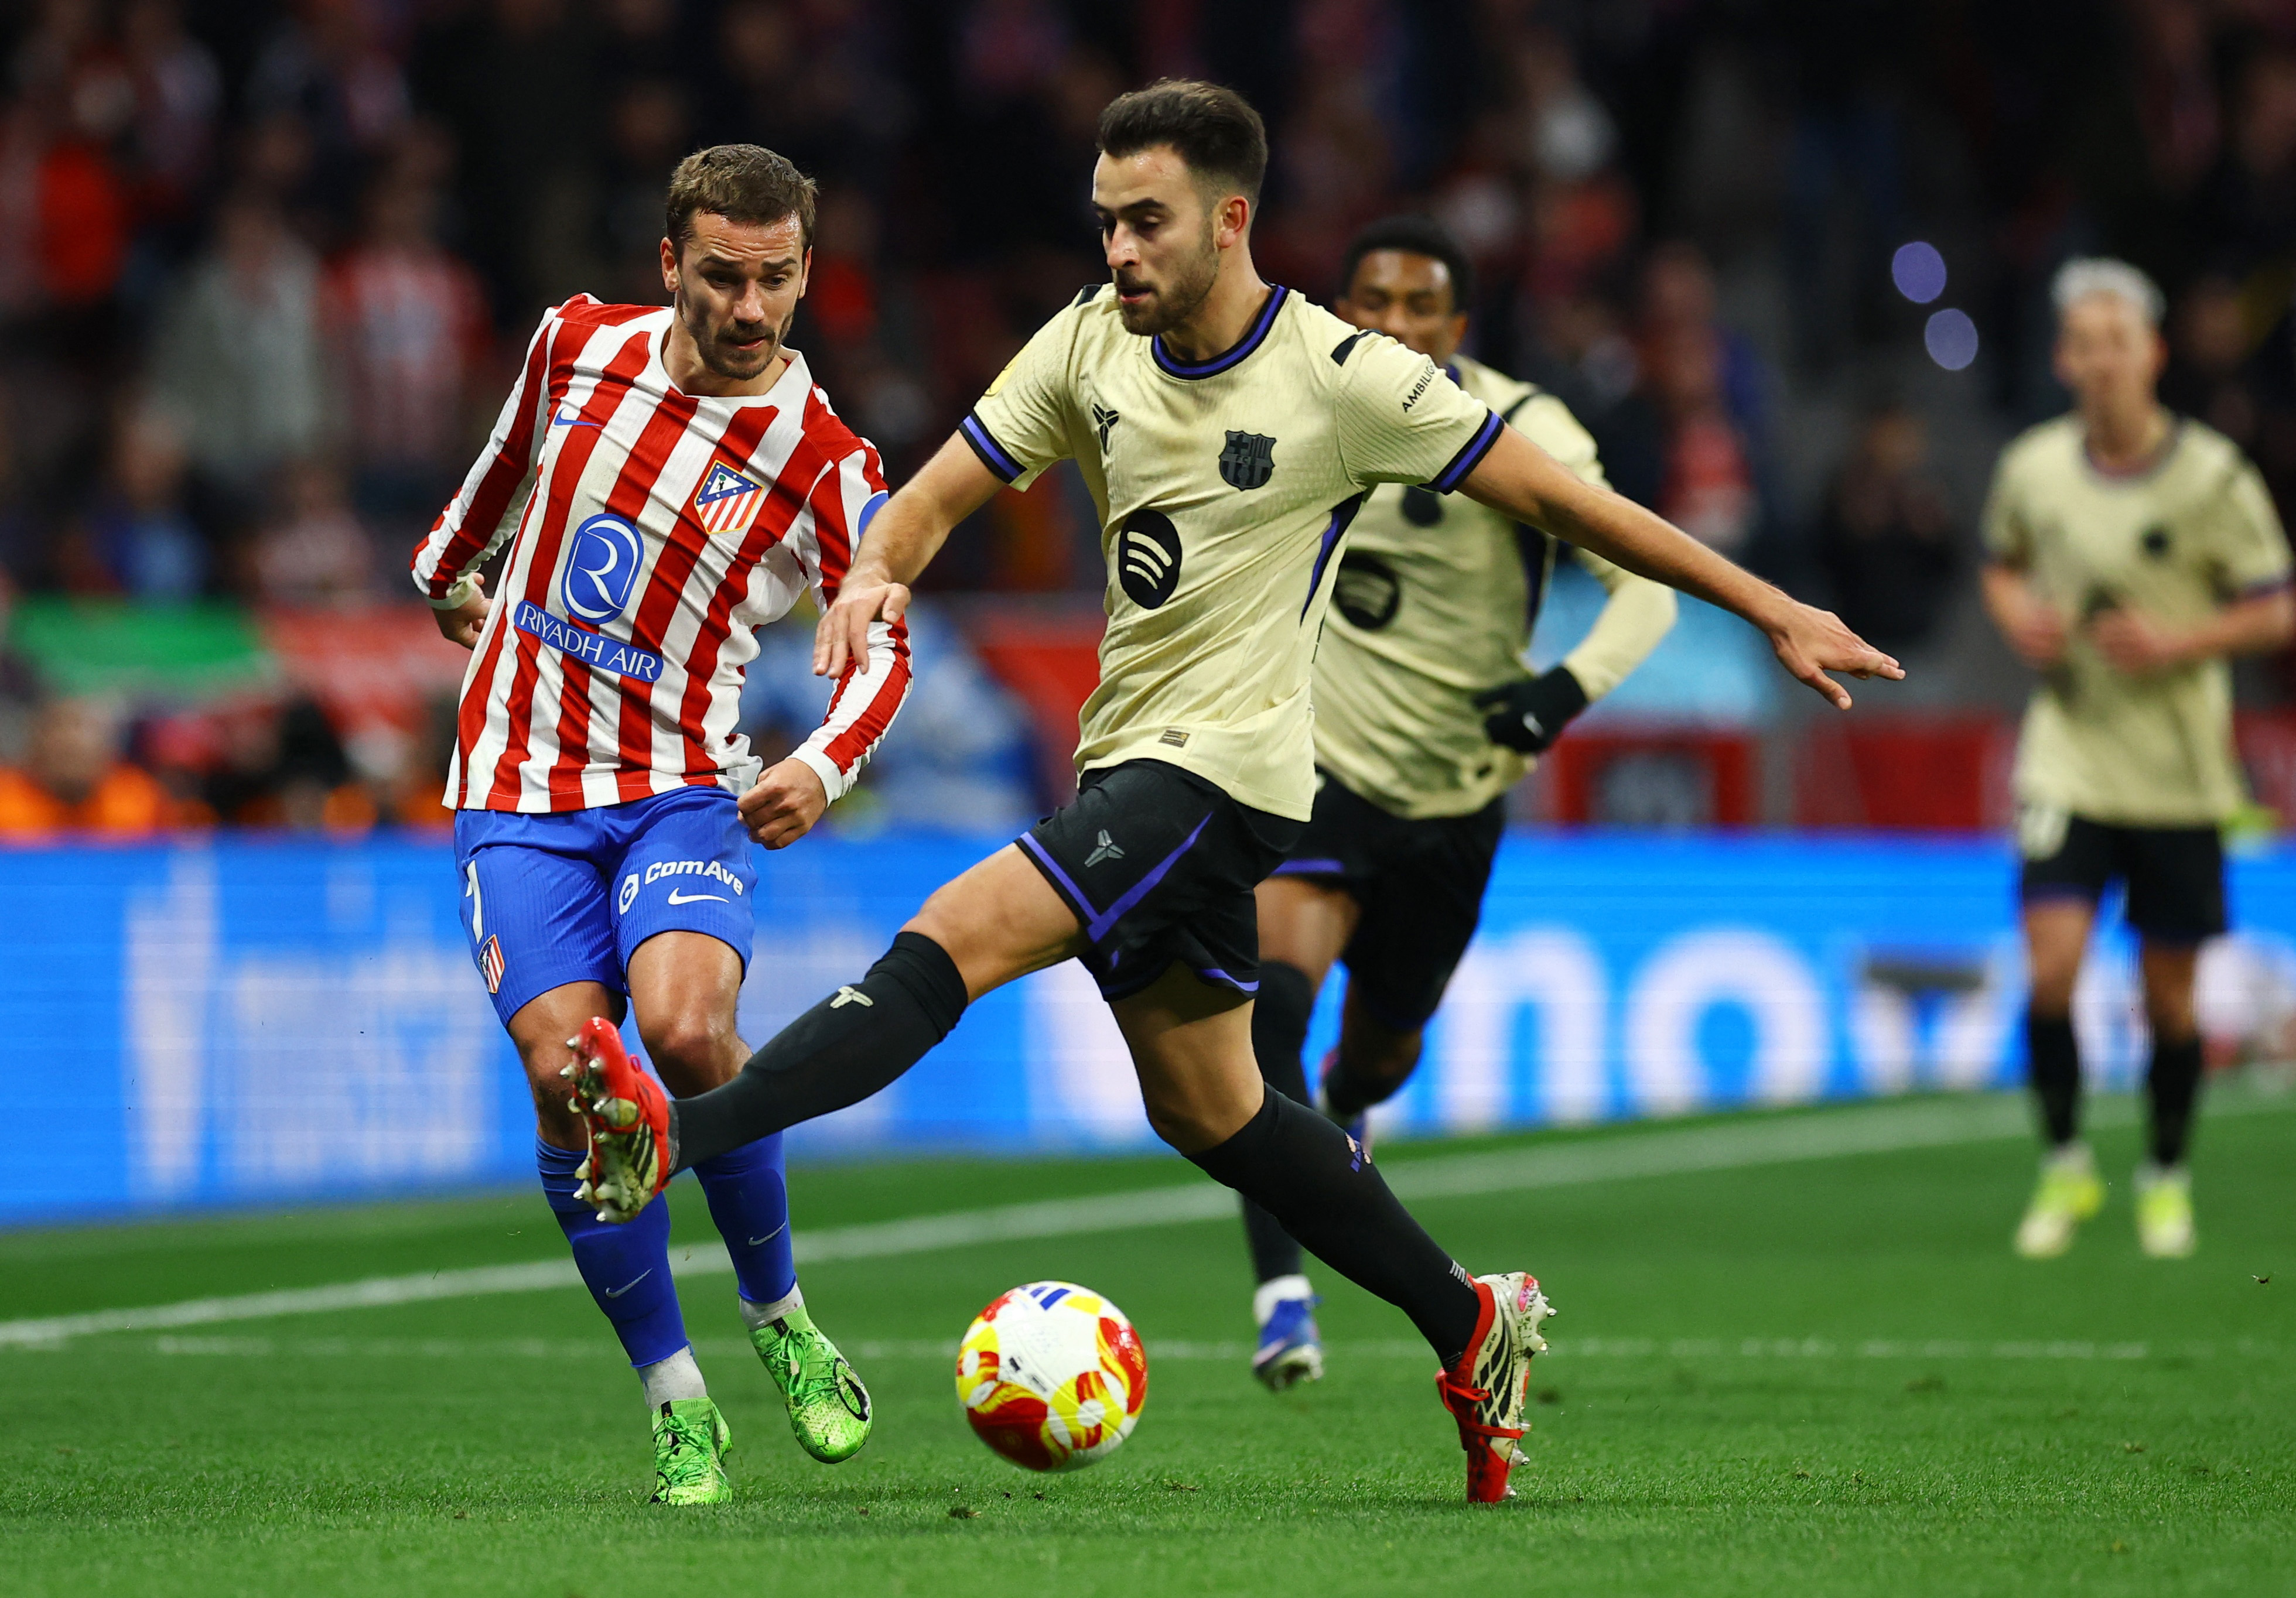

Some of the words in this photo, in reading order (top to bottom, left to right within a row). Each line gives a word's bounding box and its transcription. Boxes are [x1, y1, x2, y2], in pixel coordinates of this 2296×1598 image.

[1402, 359, 1435, 413] AMBILIG
[520, 604, 604, 662] RIYADH
[607, 647, 656, 679] AIR
[644, 860, 743, 896] ComAve
